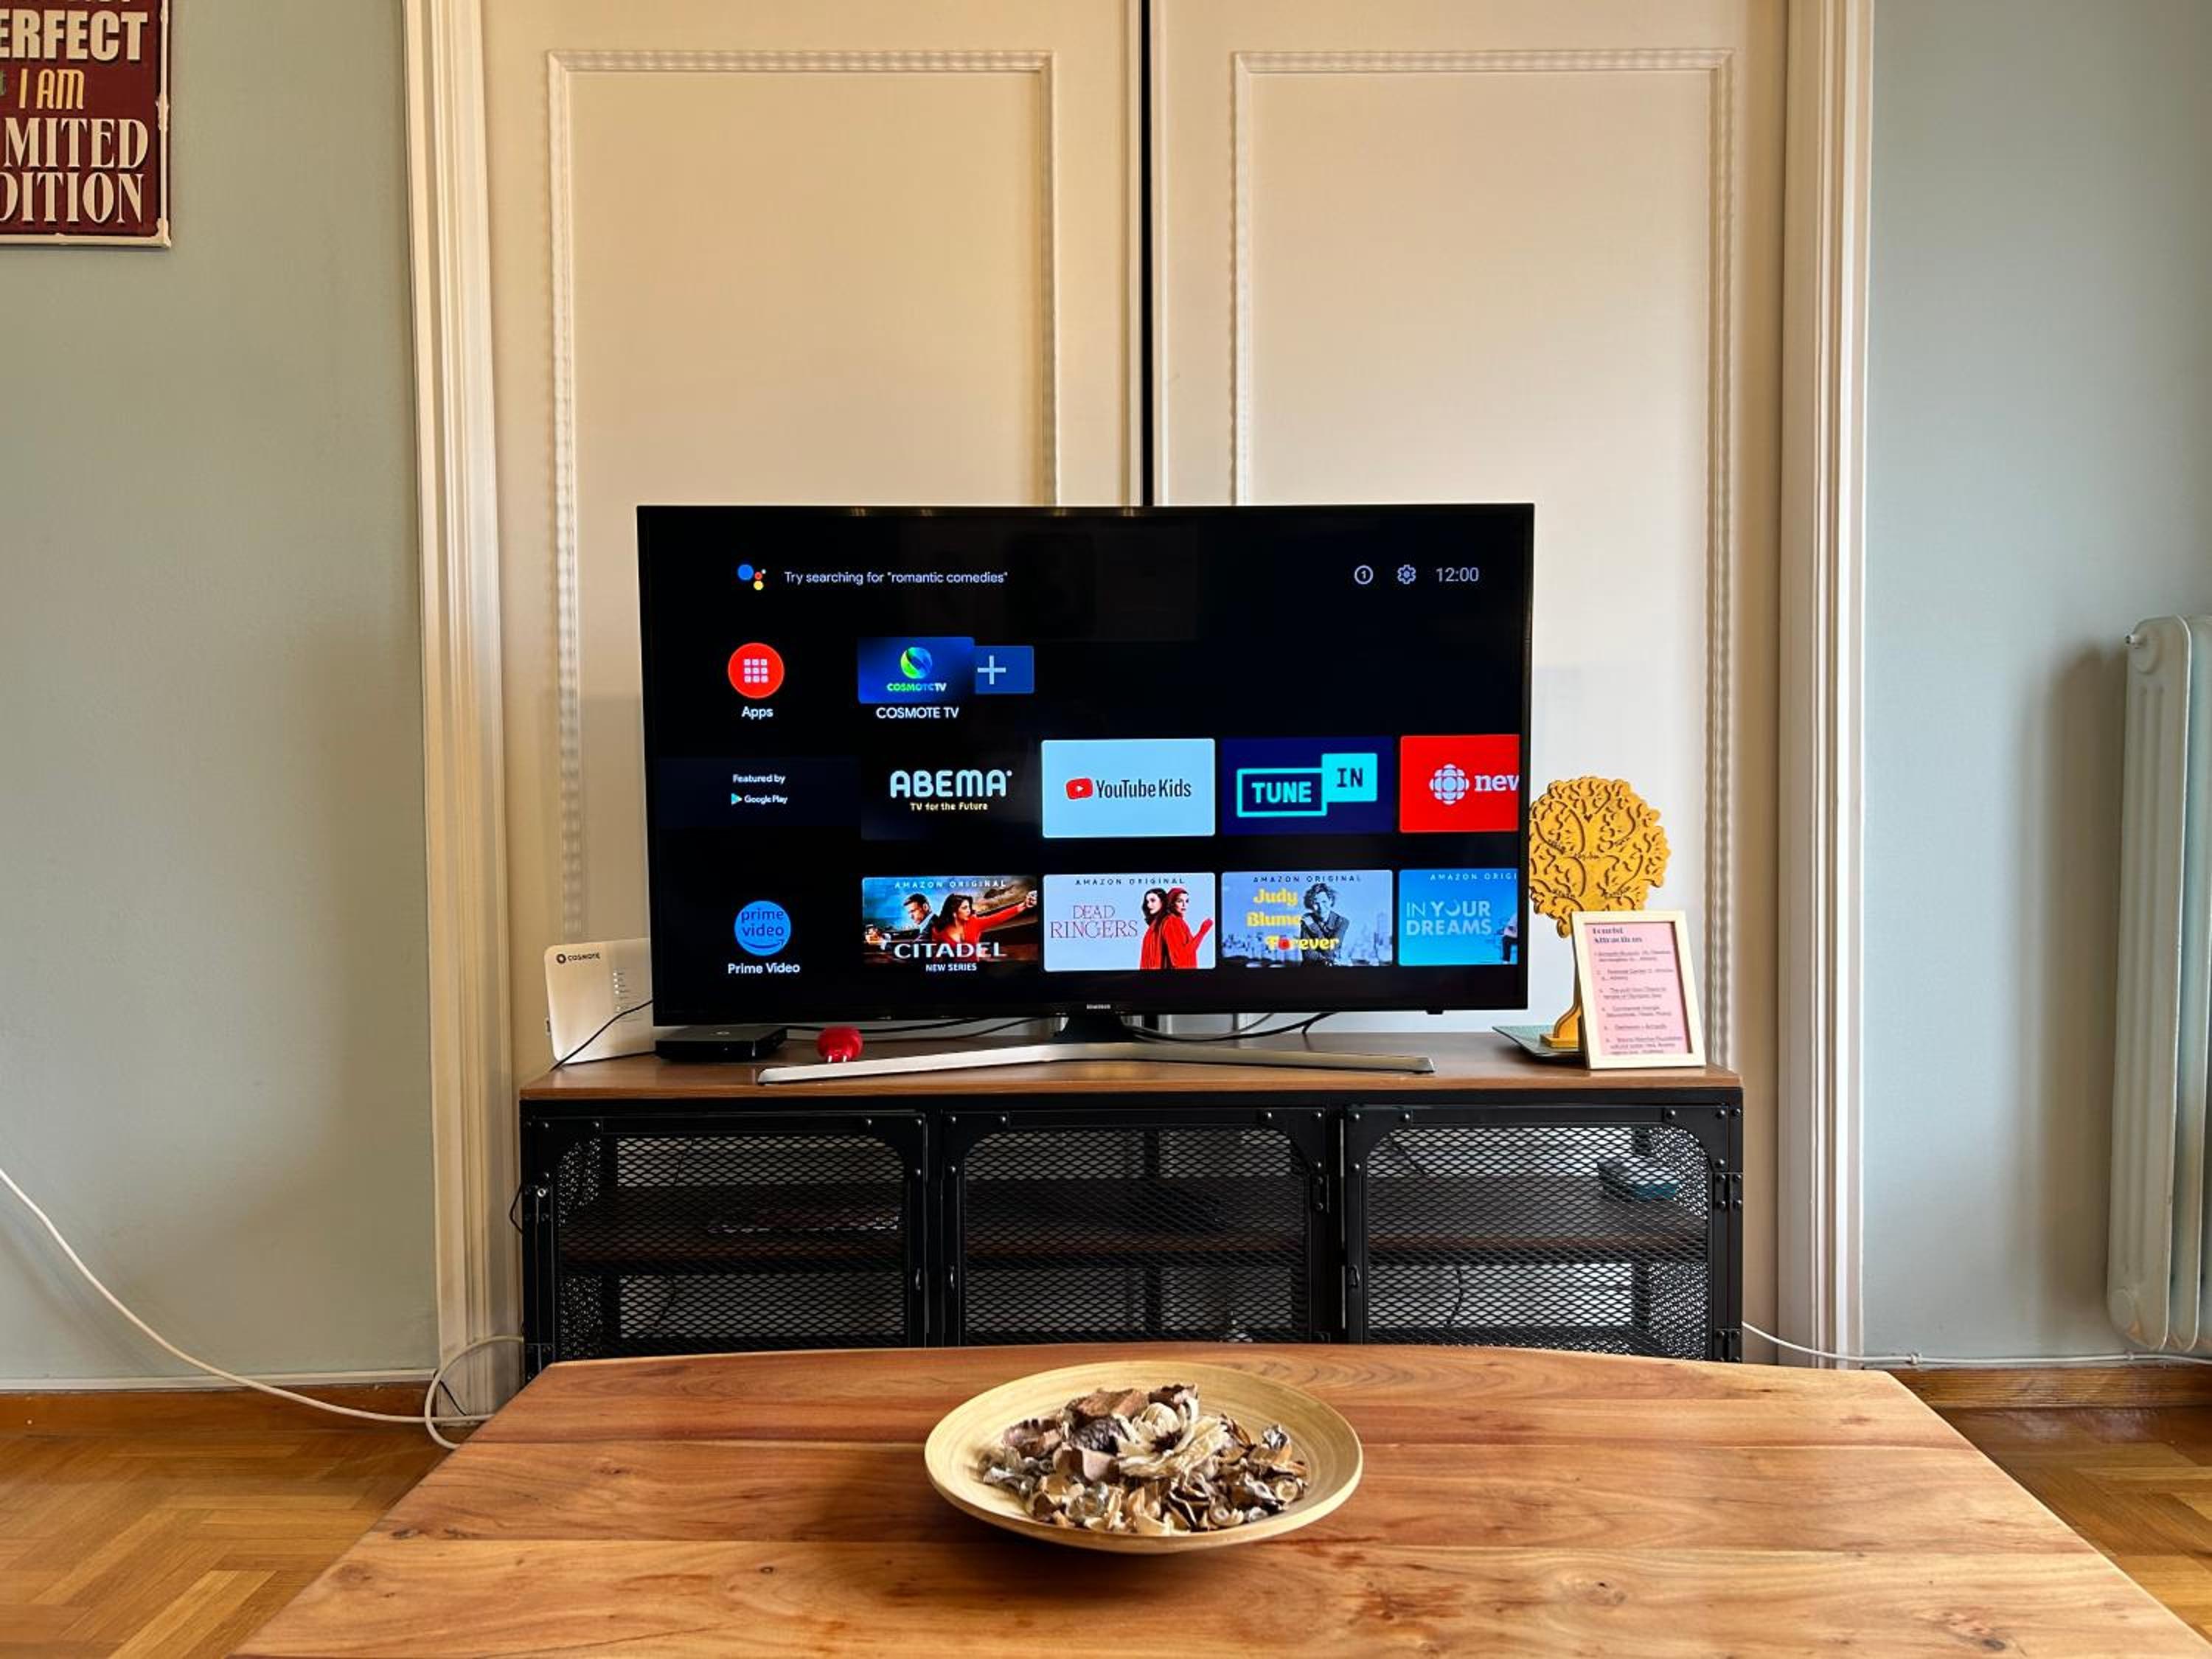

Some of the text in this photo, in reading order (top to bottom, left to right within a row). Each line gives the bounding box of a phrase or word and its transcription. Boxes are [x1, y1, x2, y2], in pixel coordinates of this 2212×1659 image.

[18, 69, 85, 109] I AM
[4, 117, 148, 168] MITED
[784, 571, 803, 585] Try
[805, 571, 863, 586] searching
[866, 571, 885, 583] for
[1436, 567, 1479, 582] 12:00
[742, 706, 773, 720] Apps
[876, 707, 959, 719] COSMOTE TV
[732, 773, 786, 785] Featured by
[890, 770, 1006, 798] ABEMA
[1336, 767, 1363, 788] IN
[1096, 778, 1192, 799] YouTube Kids
[1251, 781, 1312, 804] TUNE
[744, 794, 788, 805] Google Play
[910, 802, 988, 811] TV for the Future
[1306, 874, 1363, 883] ORIGINAL
[1430, 873, 1478, 881] AMAZON
[894, 880, 943, 889] AMAZON
[1253, 888, 1298, 906] Judy
[741, 908, 785, 922] prime
[1073, 905, 1116, 919] DEAD
[1406, 900, 1491, 918] IN YOUR
[742, 925, 785, 937] video
[1050, 921, 1138, 939] RINGERS
[1406, 919, 1492, 936] DREAMS
[894, 942, 1008, 959] CITADEL
[728, 962, 801, 974] Prime Video
[925, 963, 978, 972] NEW SERIES
